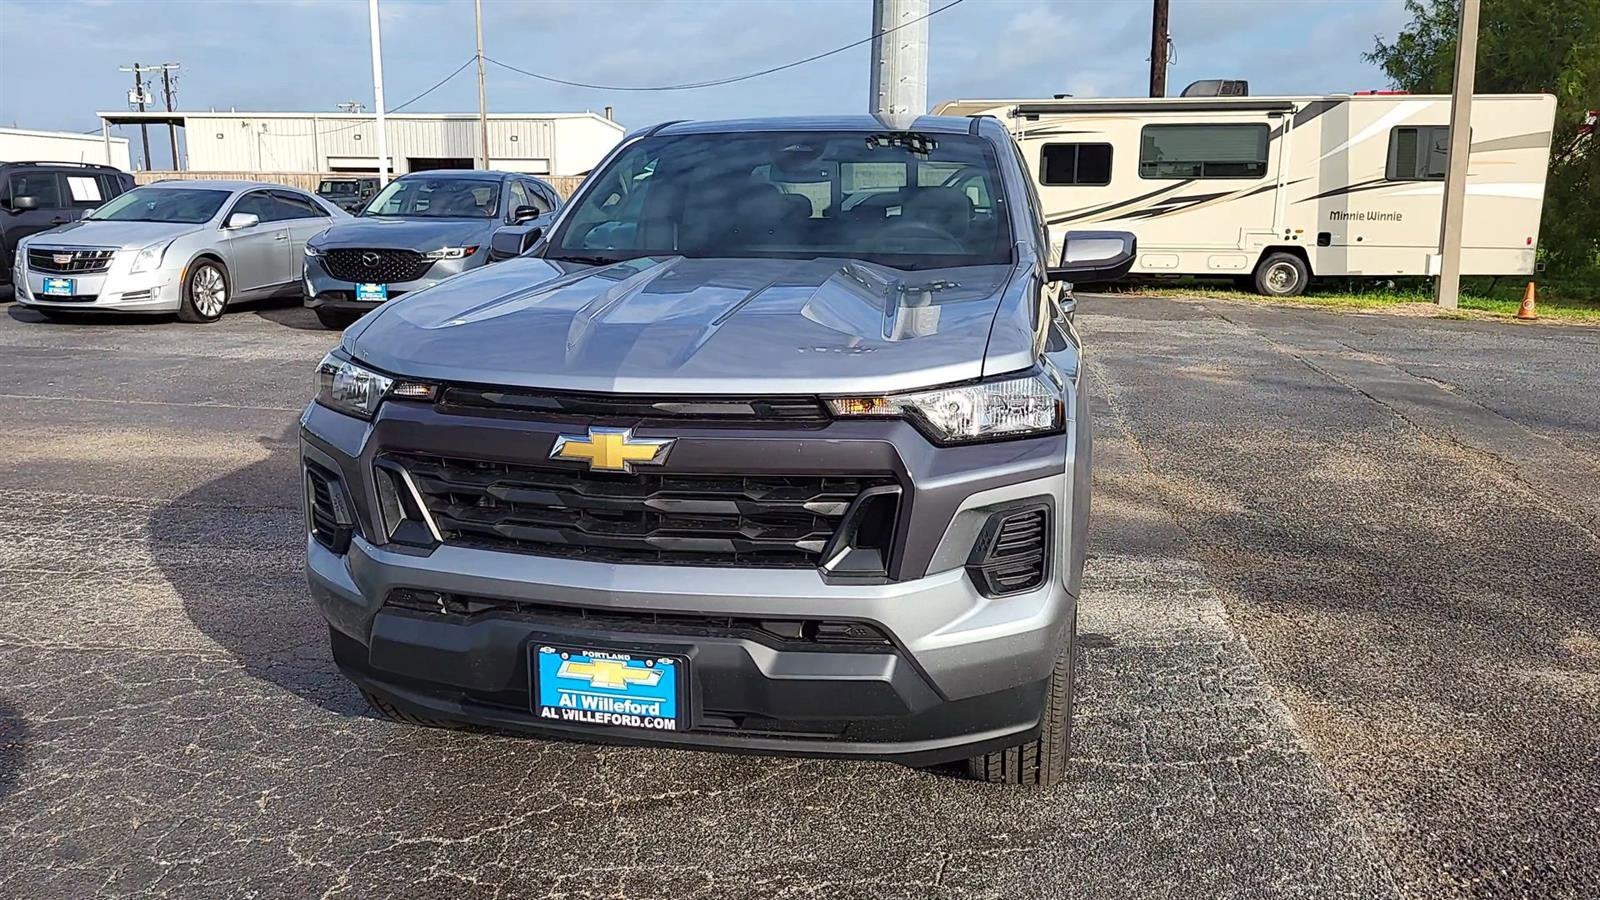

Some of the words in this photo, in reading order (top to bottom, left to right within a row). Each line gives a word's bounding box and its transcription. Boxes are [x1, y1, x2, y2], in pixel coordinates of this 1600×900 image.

[1329, 210, 1365, 221] Minnie
[1366, 211, 1403, 221] Winnie
[582, 650, 631, 661] PORTLAND
[558, 693, 576, 708] Al
[580, 695, 660, 716] Willeford
[541, 706, 559, 719] AL
[561, 708, 676, 730] WILLEFORD.COM
